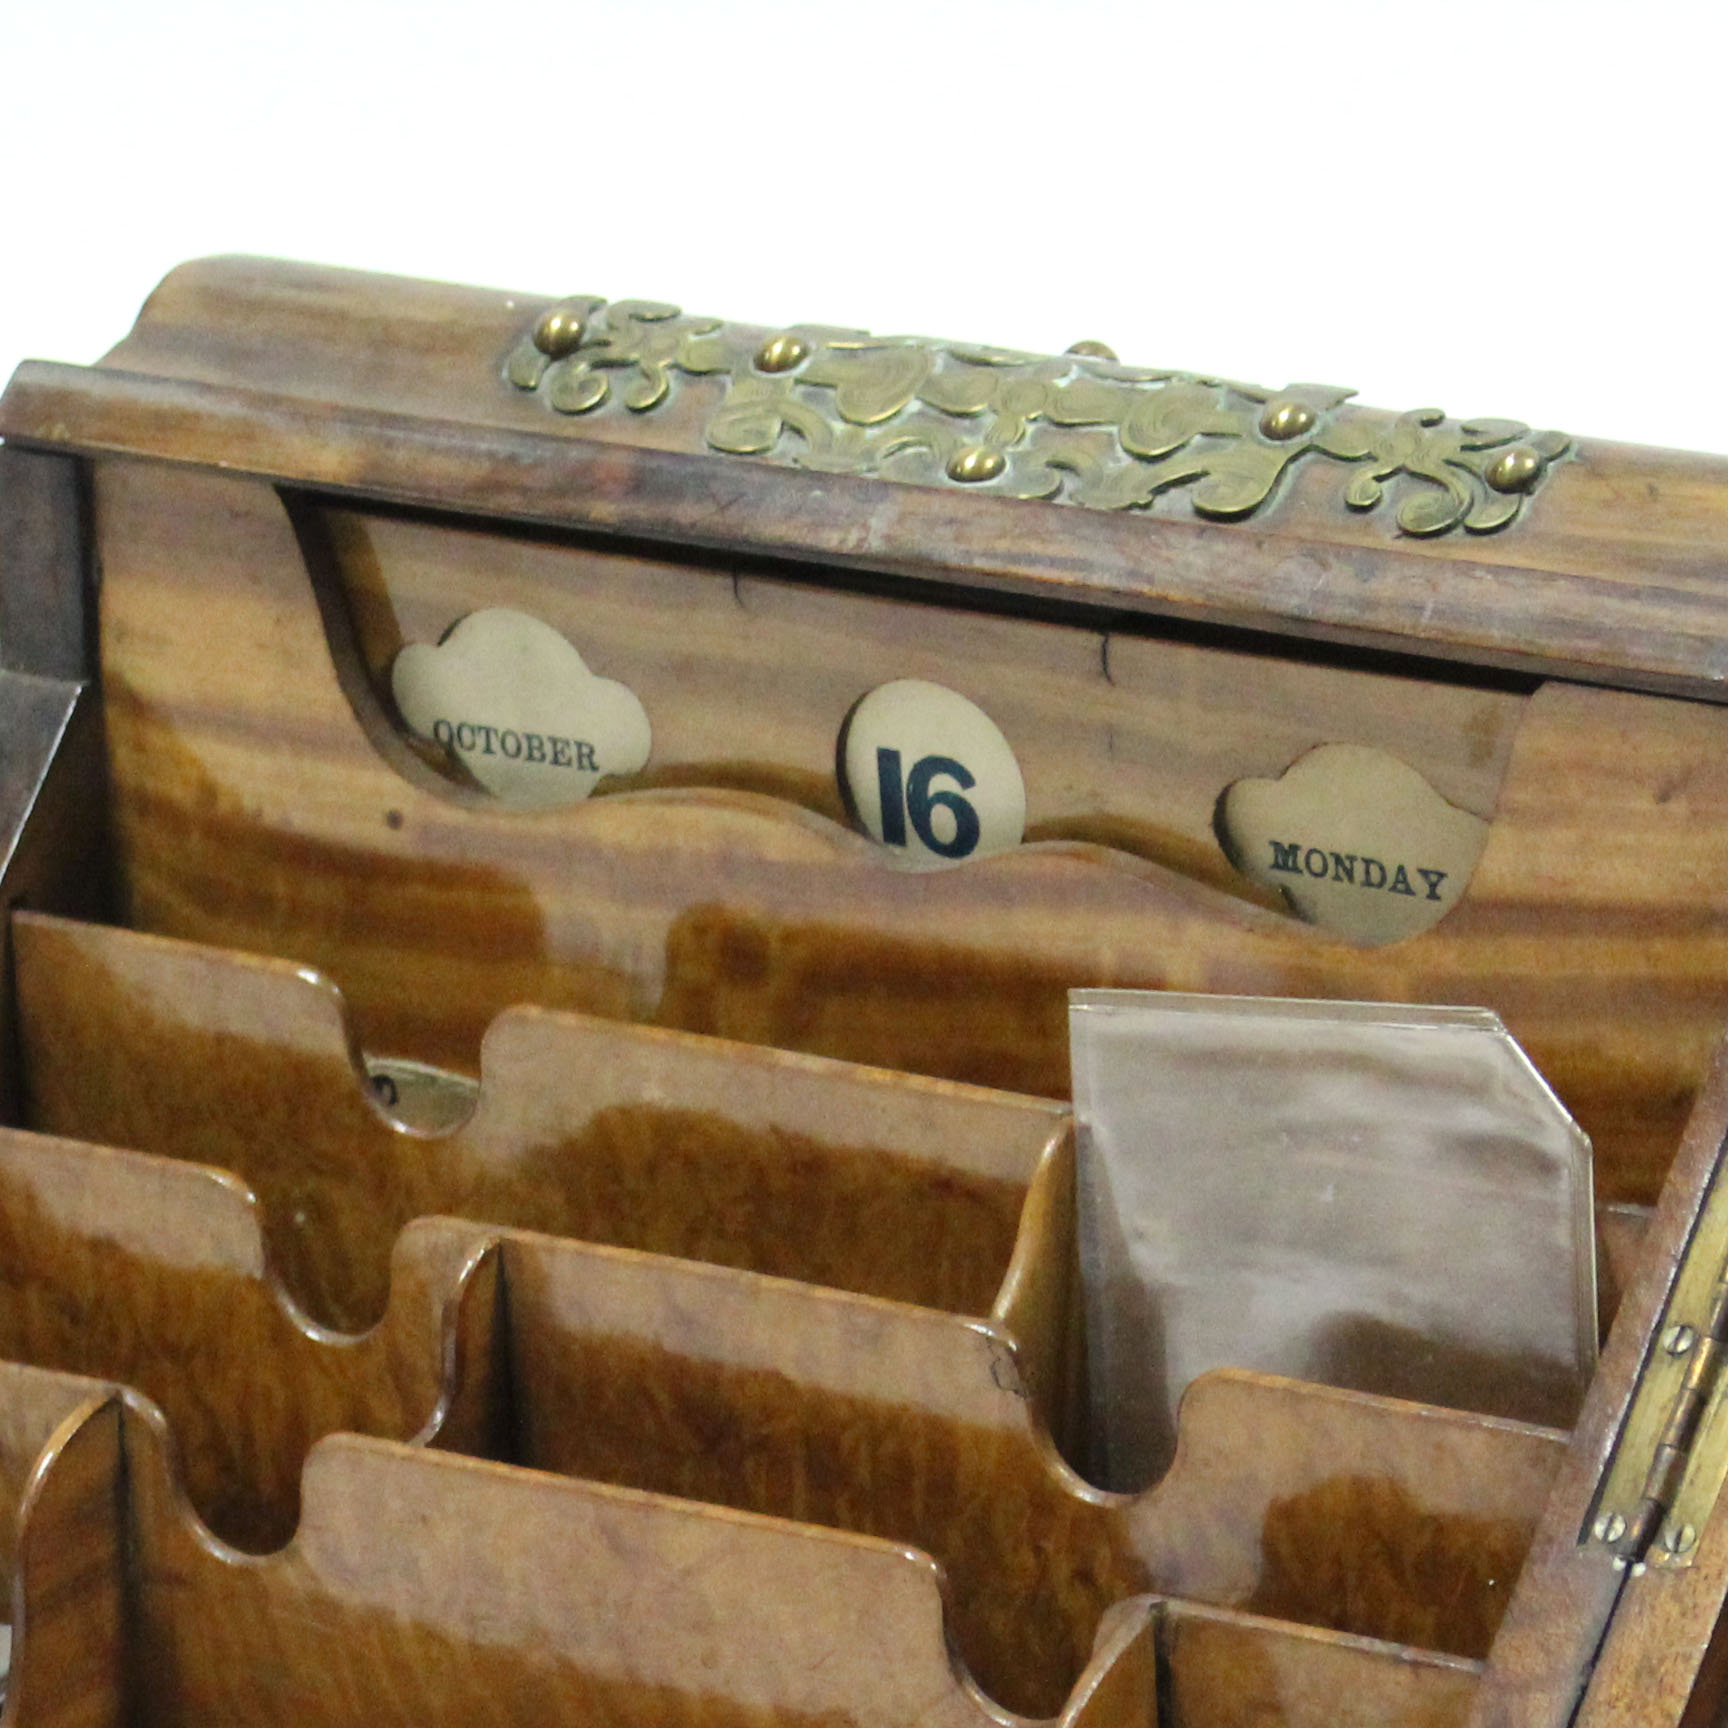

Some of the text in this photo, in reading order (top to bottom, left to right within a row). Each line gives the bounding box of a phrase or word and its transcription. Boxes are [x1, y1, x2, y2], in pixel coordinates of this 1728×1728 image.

[433, 719, 600, 772] OCTOBER
[877, 746, 980, 859] 16
[1269, 840, 1449, 901] MONDAY
